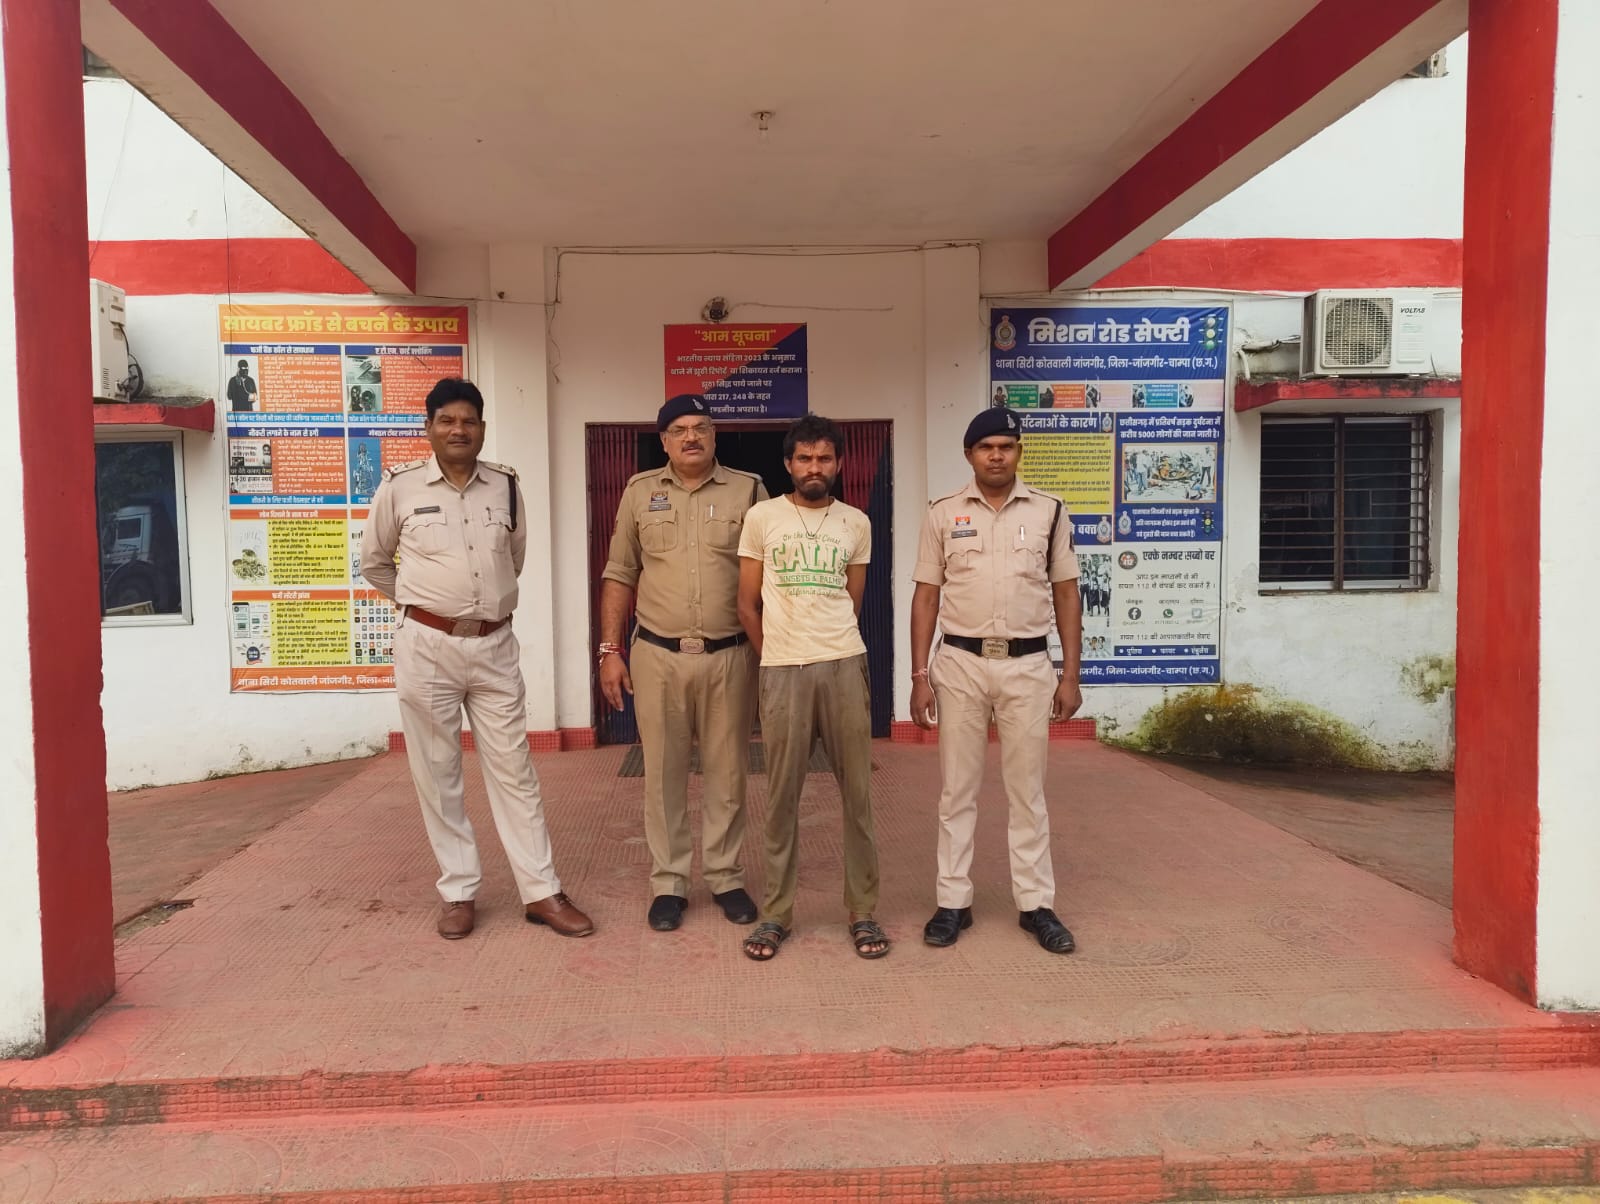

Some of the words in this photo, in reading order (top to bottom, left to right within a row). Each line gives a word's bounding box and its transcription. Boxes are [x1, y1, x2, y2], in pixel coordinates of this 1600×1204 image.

[287, 310, 323, 332] फ्रॉड
[325, 310, 342, 332] से
[344, 311, 389, 332] बचने
[392, 311, 411, 332] के
[413, 316, 459, 332] उपाय
[1027, 316, 1094, 343] मिशन
[1098, 316, 1131, 343] रोड
[1133, 316, 1191, 343] सेफ्टी
[677, 354, 702, 362] भारतीय
[703, 354, 721, 362] न्याय
[722, 353, 742, 362] संहिता
[743, 354, 762, 362] 2023
[762, 353, 770, 362] के
[771, 354, 796, 364] अनुसार
[995, 359, 1015, 369] थाना
[1016, 356, 1034, 369] सिटी
[1036, 356, 1071, 369] कोतवाली
[1073, 356, 1106, 369] जांजगीर,
[708, 366, 727, 375] रिपोर्ट
[739, 366, 768, 374] शिकायत
[769, 365, 780, 374] दर्ज
[746, 378, 762, 388] जाने
[763, 380, 772, 388] पर
[747, 391, 755, 400] के
[736, 405, 760, 413] अपराध
[1020, 414, 1058, 429] र्घटनाओं
[1060, 414, 1069, 428] के
[1070, 417, 1098, 428] कारण
[283, 429, 289, 437] के
[1138, 430, 1155, 438] 5000
[1172, 428, 1182, 438] की
[1182, 430, 1196, 438] जान
[1078, 524, 1098, 535] वक्त
[1142, 549, 1160, 560] एक्के
[1161, 551, 1183, 560] नम्बर
[260, 675, 278, 686] सिटी
[281, 675, 318, 686] कोतवाली
